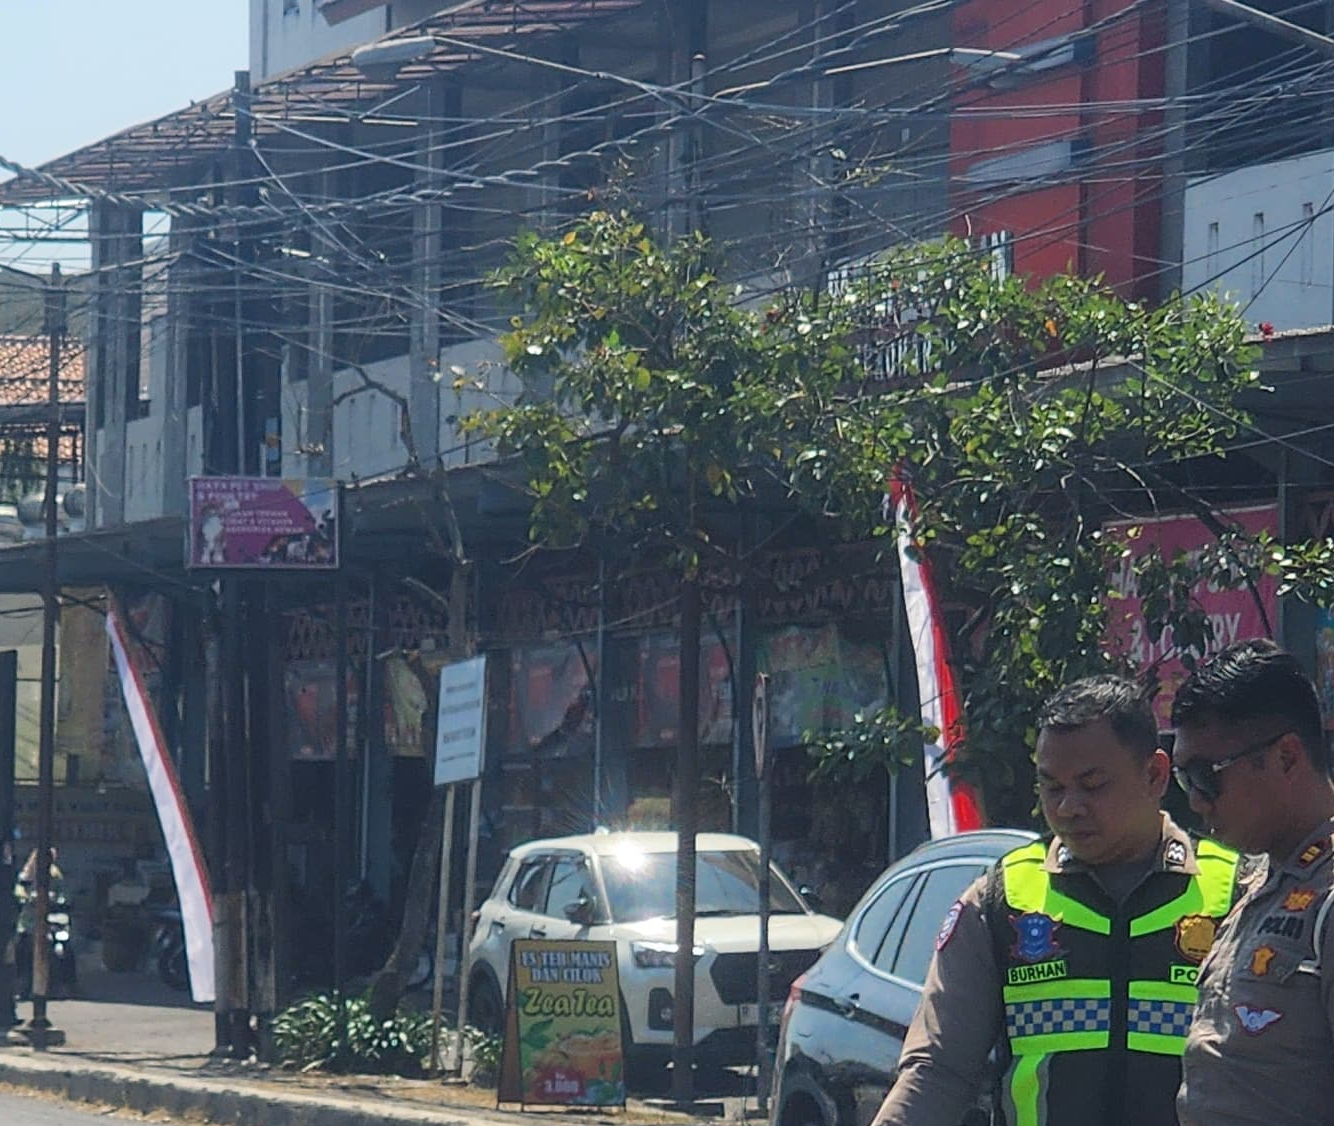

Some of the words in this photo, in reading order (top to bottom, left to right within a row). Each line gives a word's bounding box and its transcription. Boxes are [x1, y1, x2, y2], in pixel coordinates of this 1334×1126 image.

[570, 951, 611, 967] MANIS
[531, 968, 557, 982] DAN
[1010, 962, 1065, 983] BURHAN
